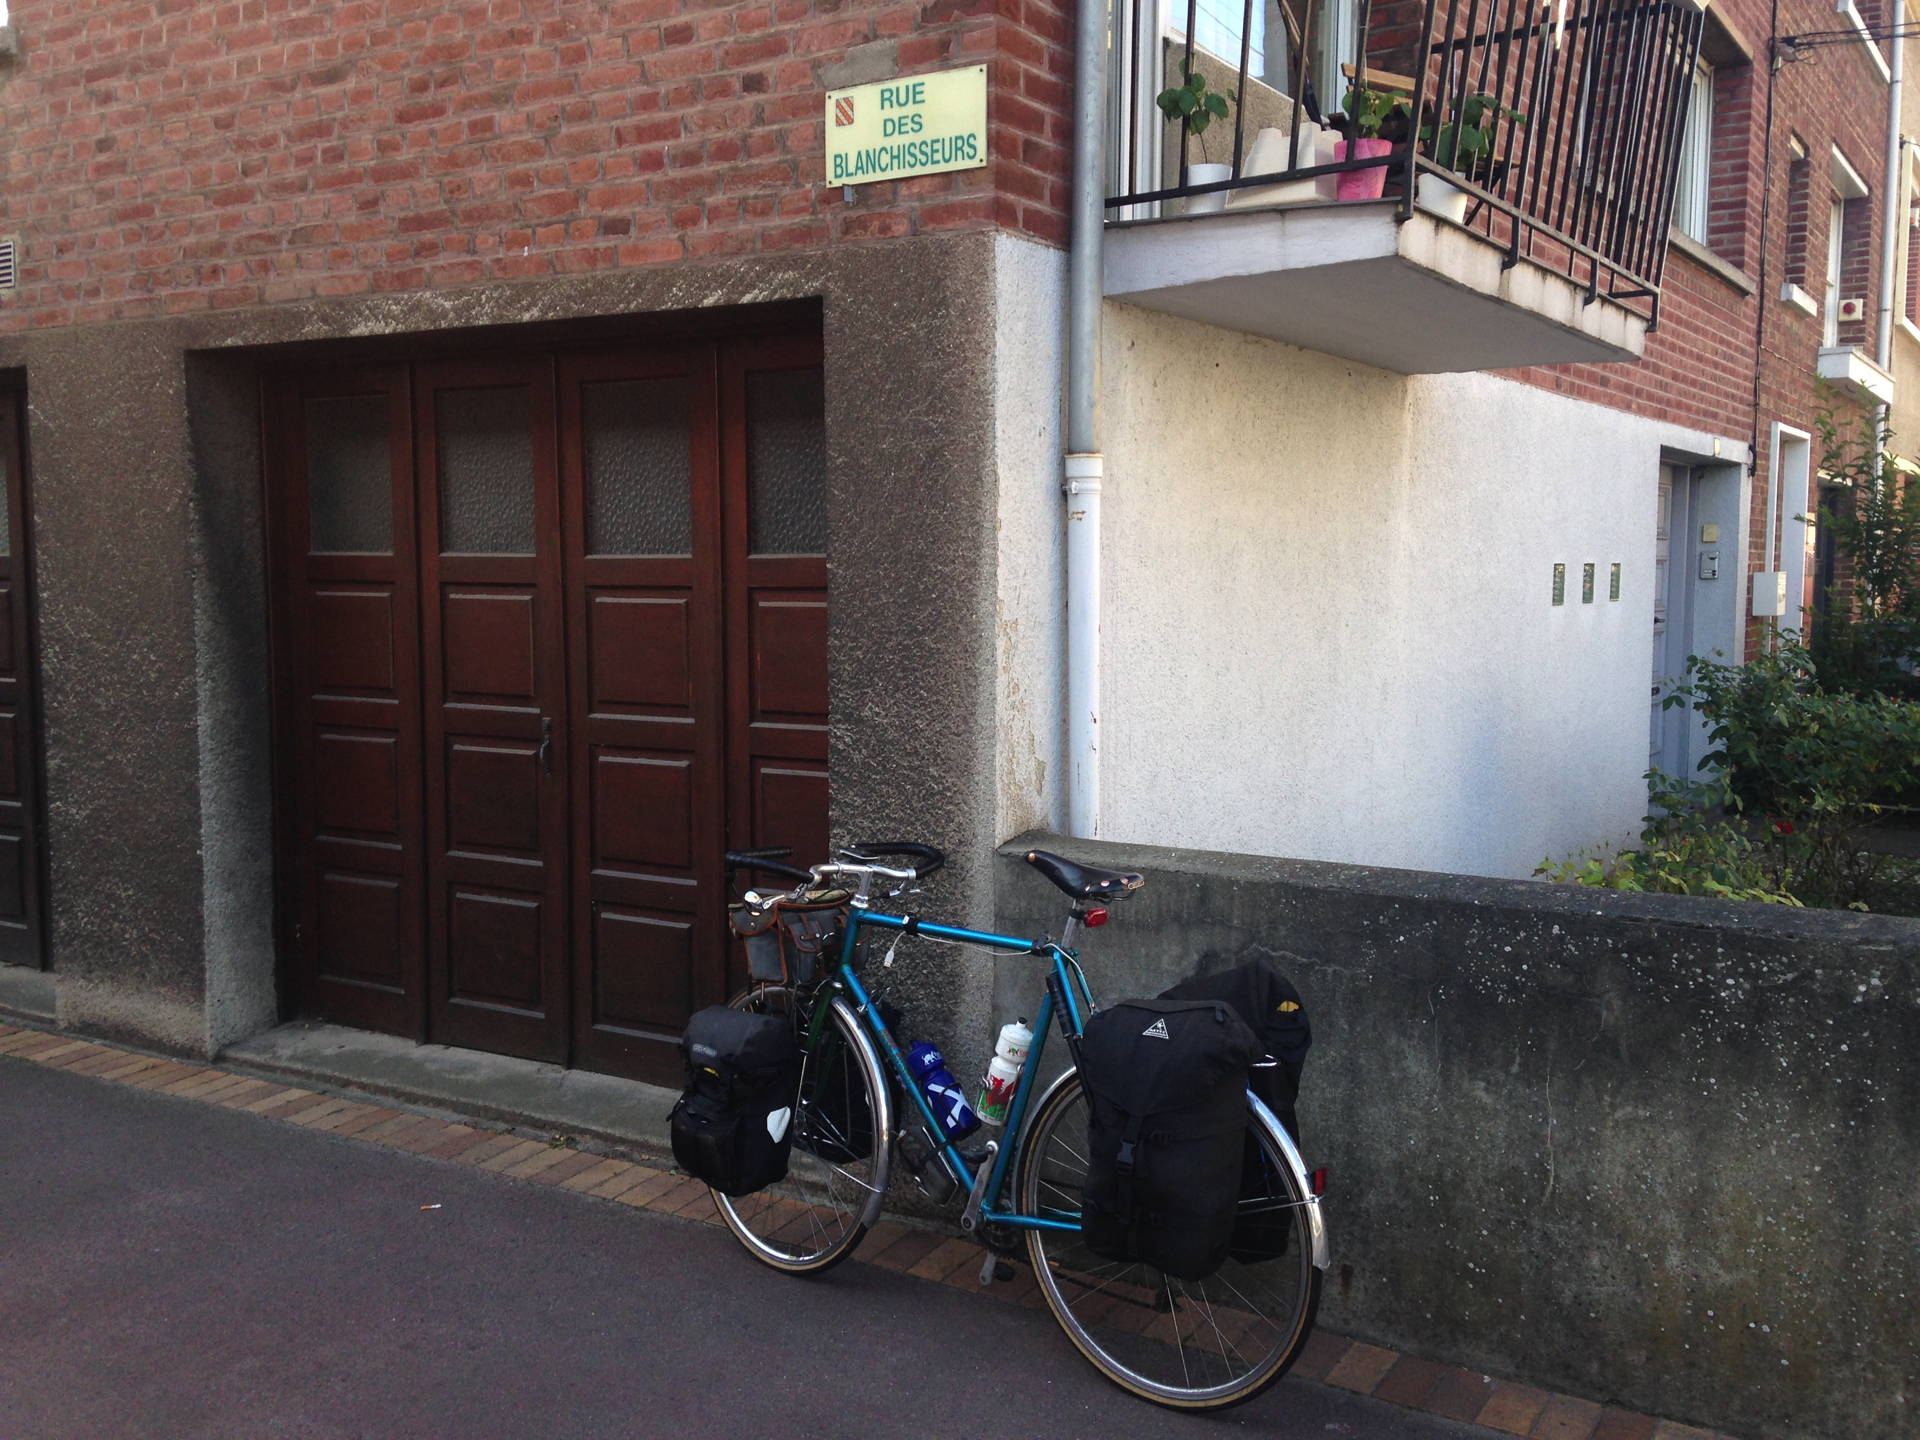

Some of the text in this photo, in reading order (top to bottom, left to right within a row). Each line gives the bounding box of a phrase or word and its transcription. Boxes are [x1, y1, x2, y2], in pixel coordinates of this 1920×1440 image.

[880, 82, 925, 110] RUE
[883, 113, 923, 137] DES
[834, 133, 977, 179] BLANCHISSEURS
